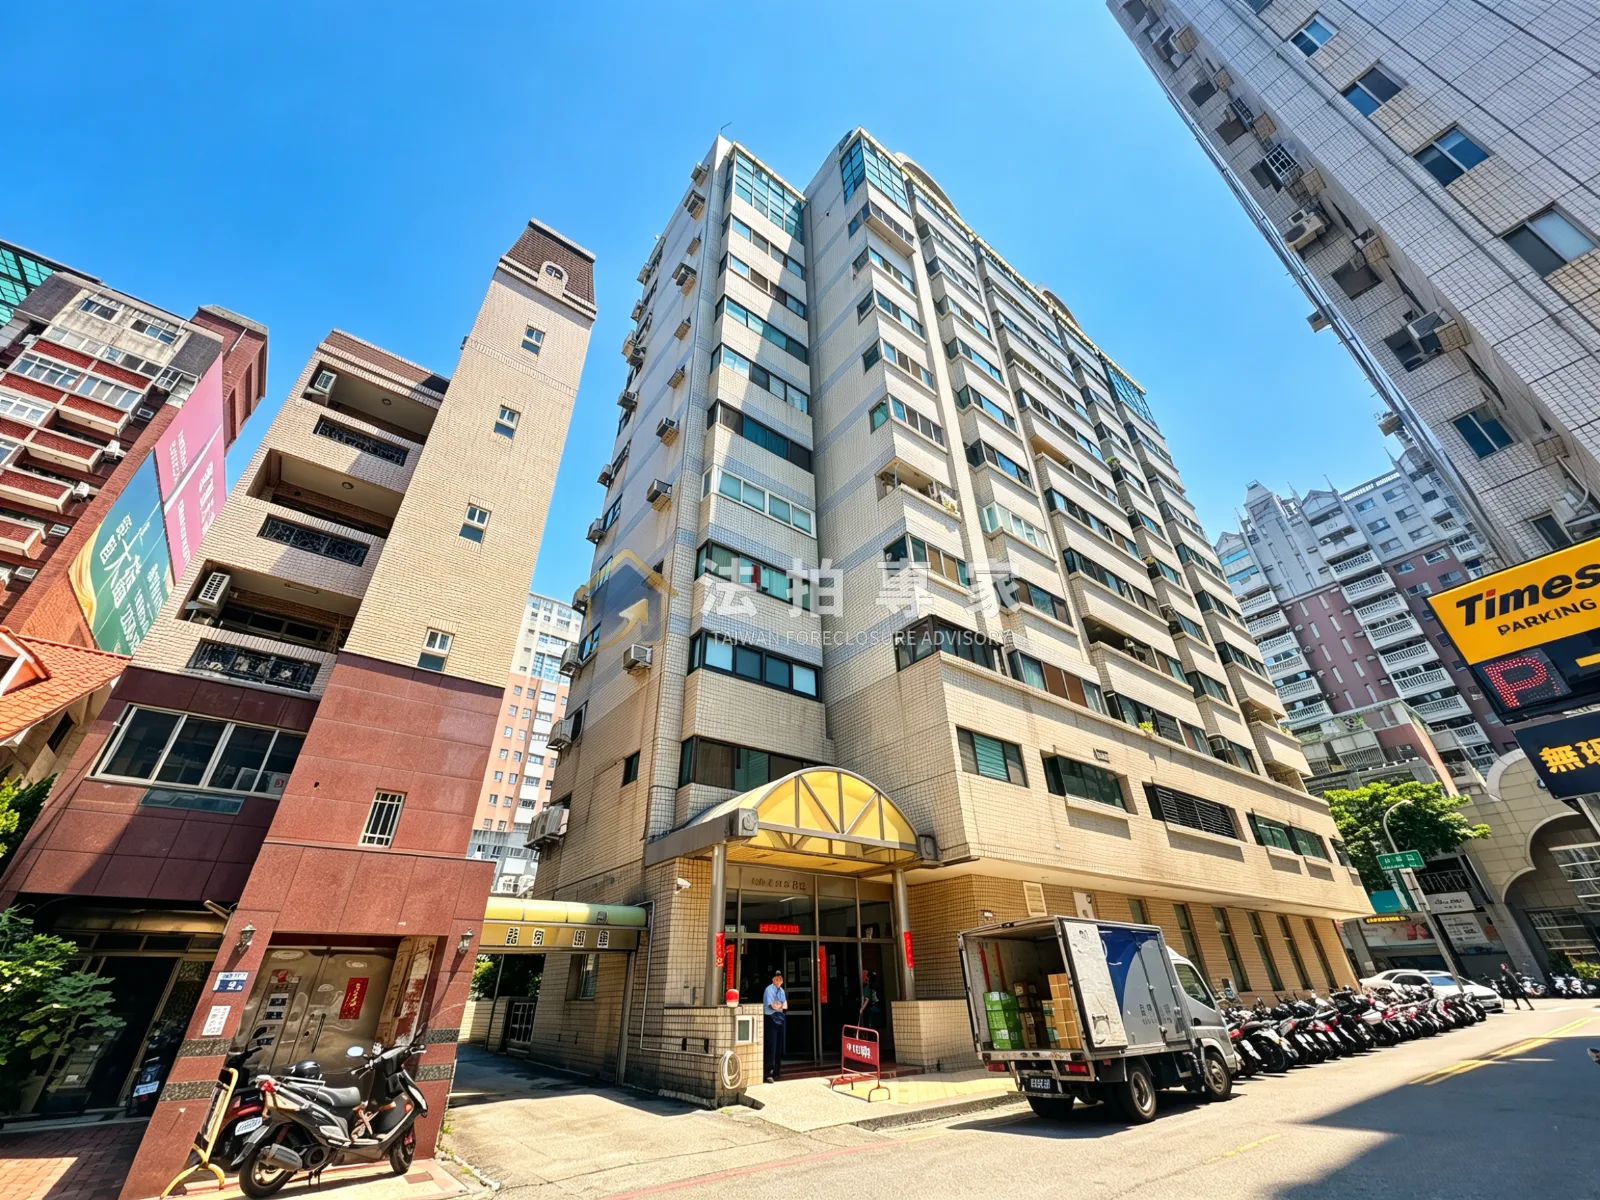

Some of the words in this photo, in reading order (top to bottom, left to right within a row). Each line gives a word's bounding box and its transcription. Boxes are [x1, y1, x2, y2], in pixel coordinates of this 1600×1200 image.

[1456, 563, 1600, 627] Times
[1497, 598, 1597, 636] PARKING
[1482, 656, 1547, 708] P
